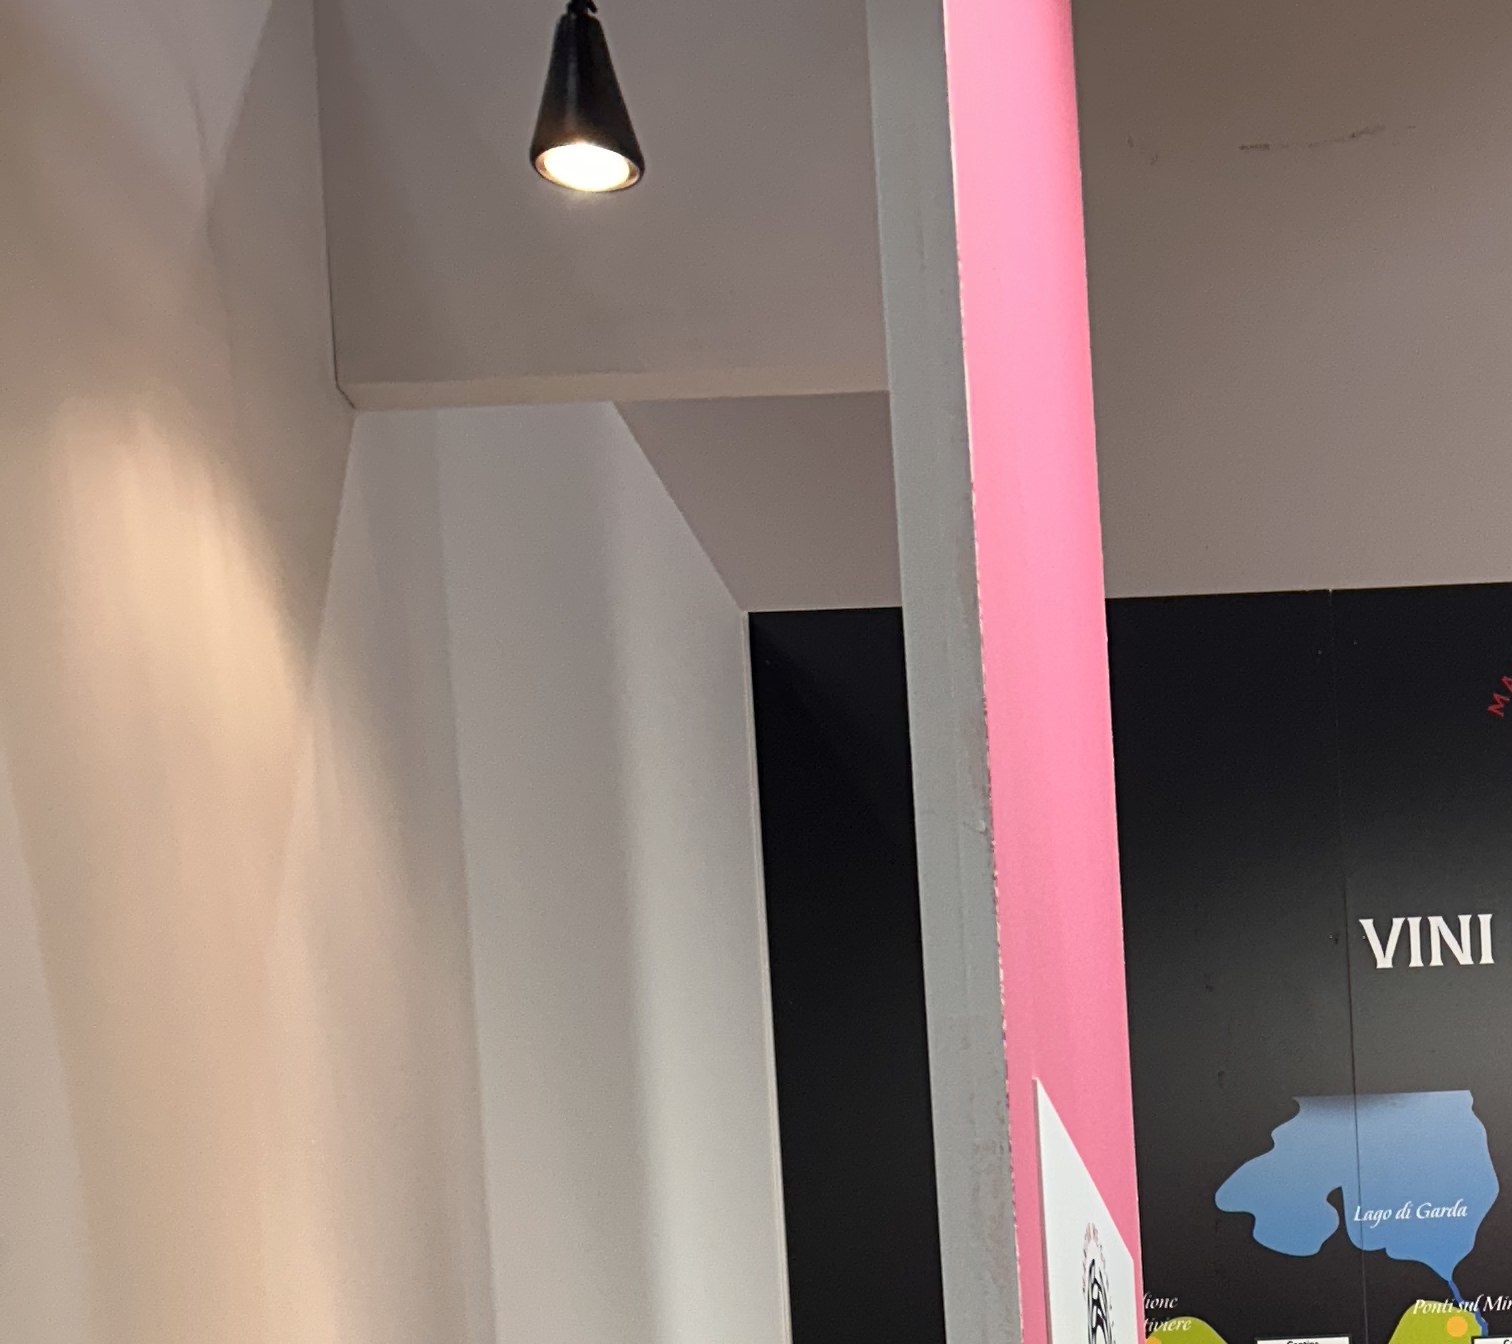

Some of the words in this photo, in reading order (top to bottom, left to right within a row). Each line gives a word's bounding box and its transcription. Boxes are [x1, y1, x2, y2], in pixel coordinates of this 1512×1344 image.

[1359, 912, 1495, 969] VINI
[1354, 1205, 1392, 1229] Lago
[1395, 1200, 1412, 1220] di
[1415, 1198, 1468, 1219] Garda
[1413, 1298, 1454, 1315] Ponti
[1457, 1294, 1485, 1312] sul
